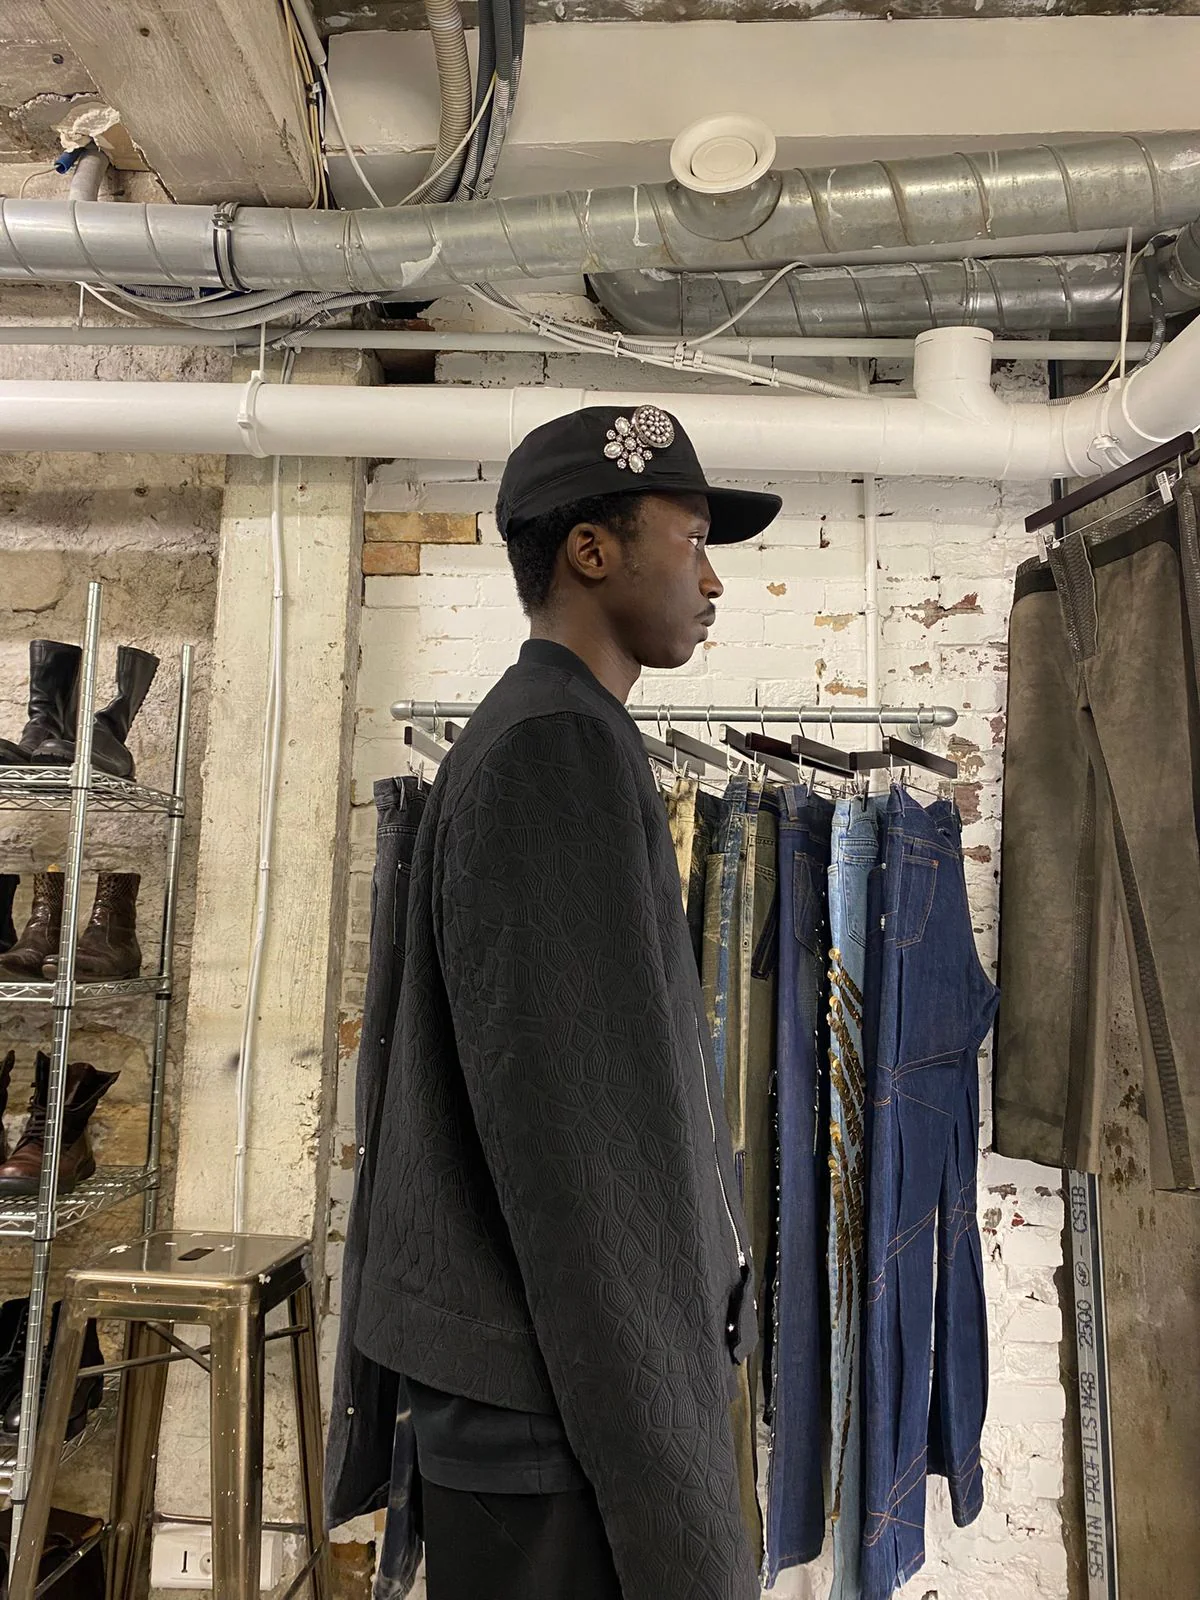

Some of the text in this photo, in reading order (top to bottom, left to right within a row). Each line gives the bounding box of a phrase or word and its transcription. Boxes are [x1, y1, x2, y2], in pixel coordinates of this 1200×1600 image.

[1071, 1186, 1088, 1233] CSTB
[1077, 1300, 1094, 1351] 2500
[1082, 1416, 1101, 1505] PROFILS
[1087, 1516, 1104, 1579] SEMIN
